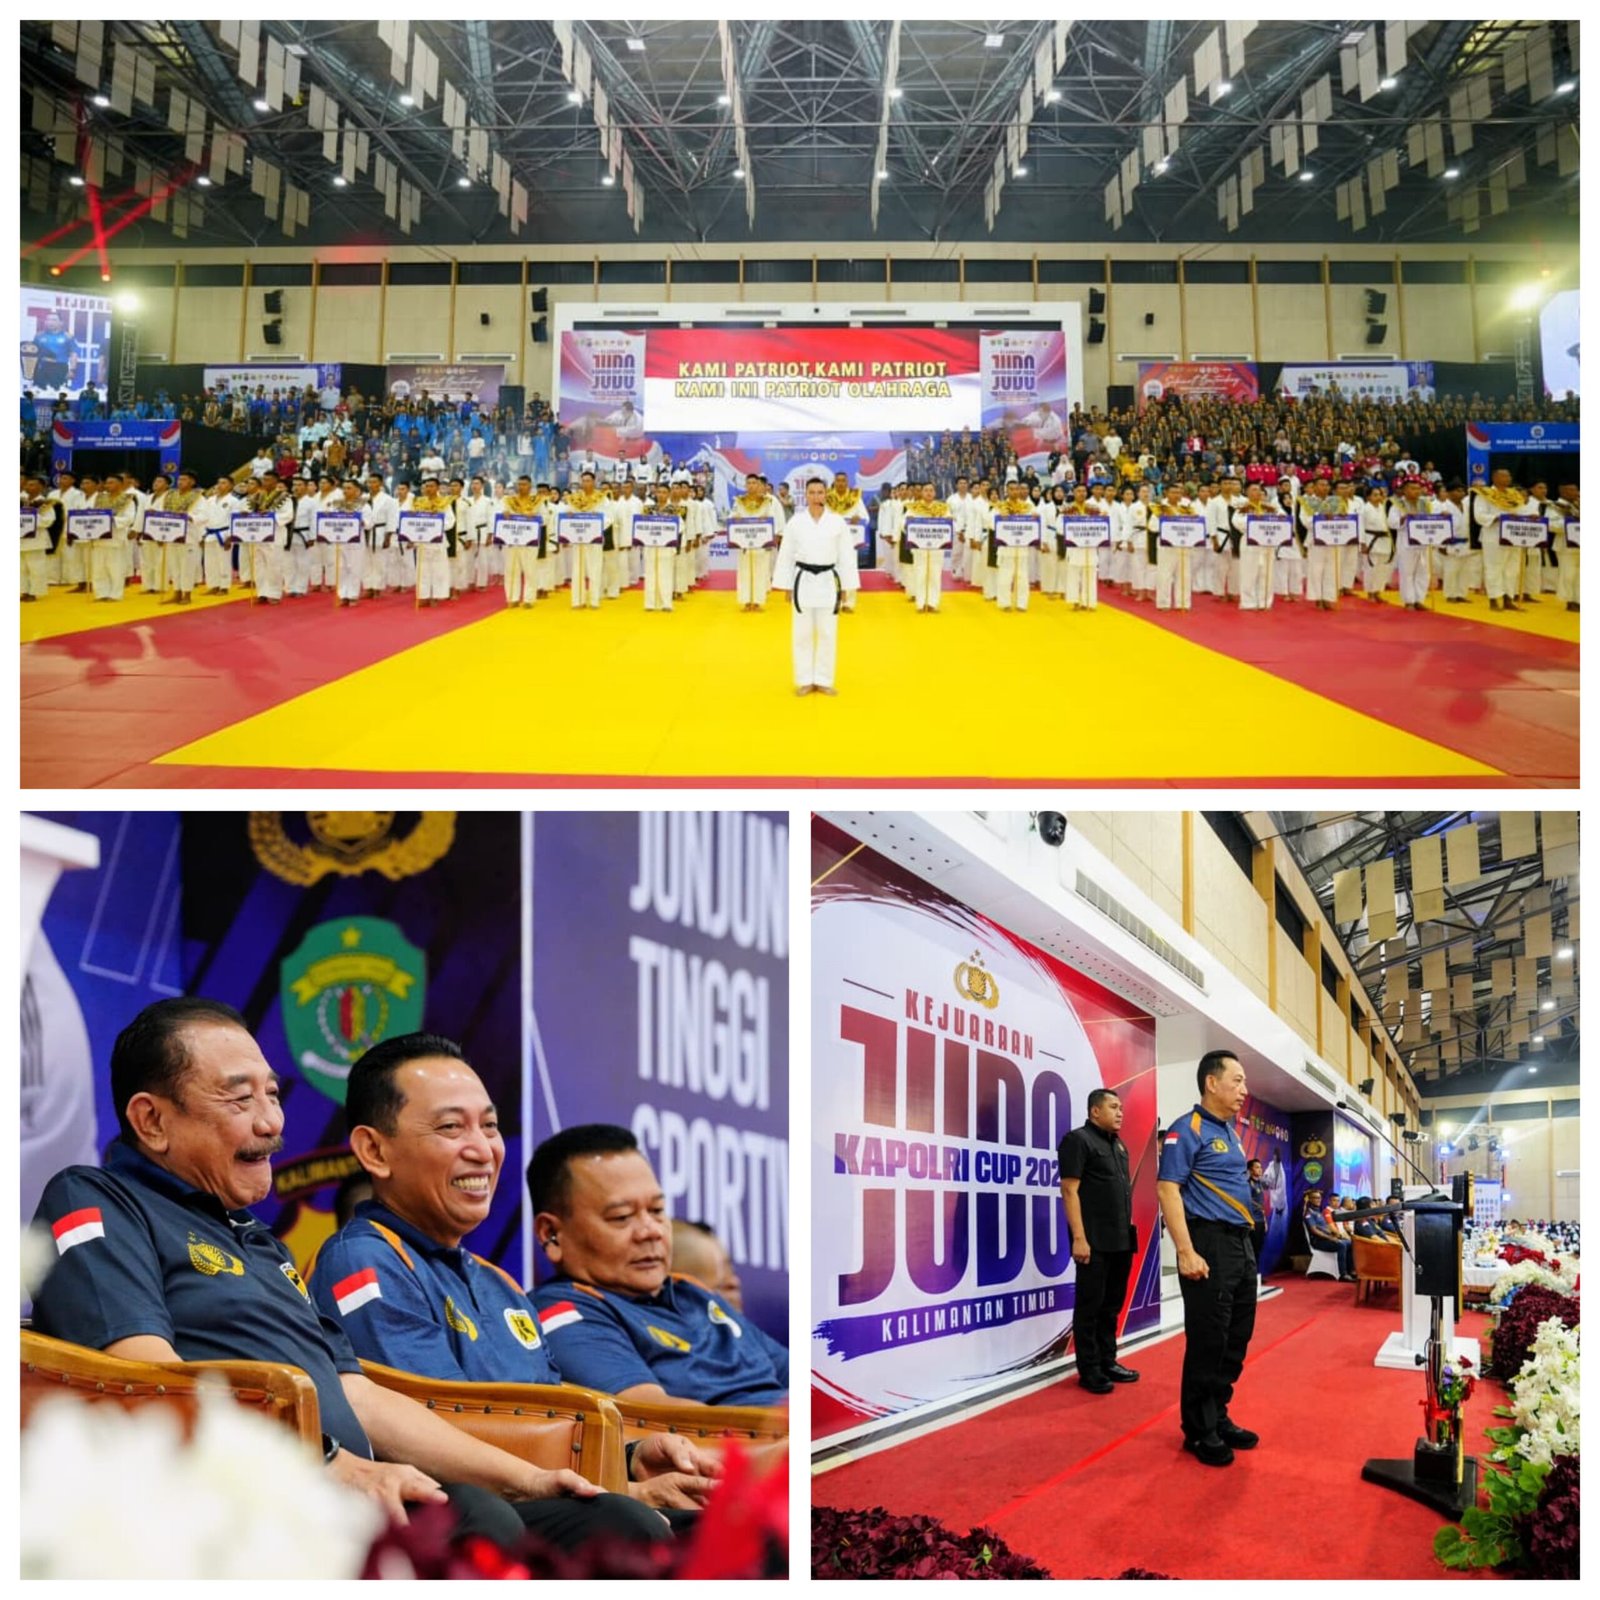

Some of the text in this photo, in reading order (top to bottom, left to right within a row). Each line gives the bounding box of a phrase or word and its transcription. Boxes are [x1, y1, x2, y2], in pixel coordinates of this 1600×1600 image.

[675, 381, 951, 397] KAMI INI PATRIOT OLAHRAGA
[678, 361, 727, 378] KAMI
[871, 361, 946, 378] PATRIOT
[630, 811, 789, 959] JUNJUN
[629, 934, 769, 1111] TINGGI
[905, 988, 1034, 1061] KEJUARAAN
[834, 1132, 1062, 1188] KAPOLRI CUP 202
[881, 1289, 1055, 1343] KALIMANTAN TIMUR
